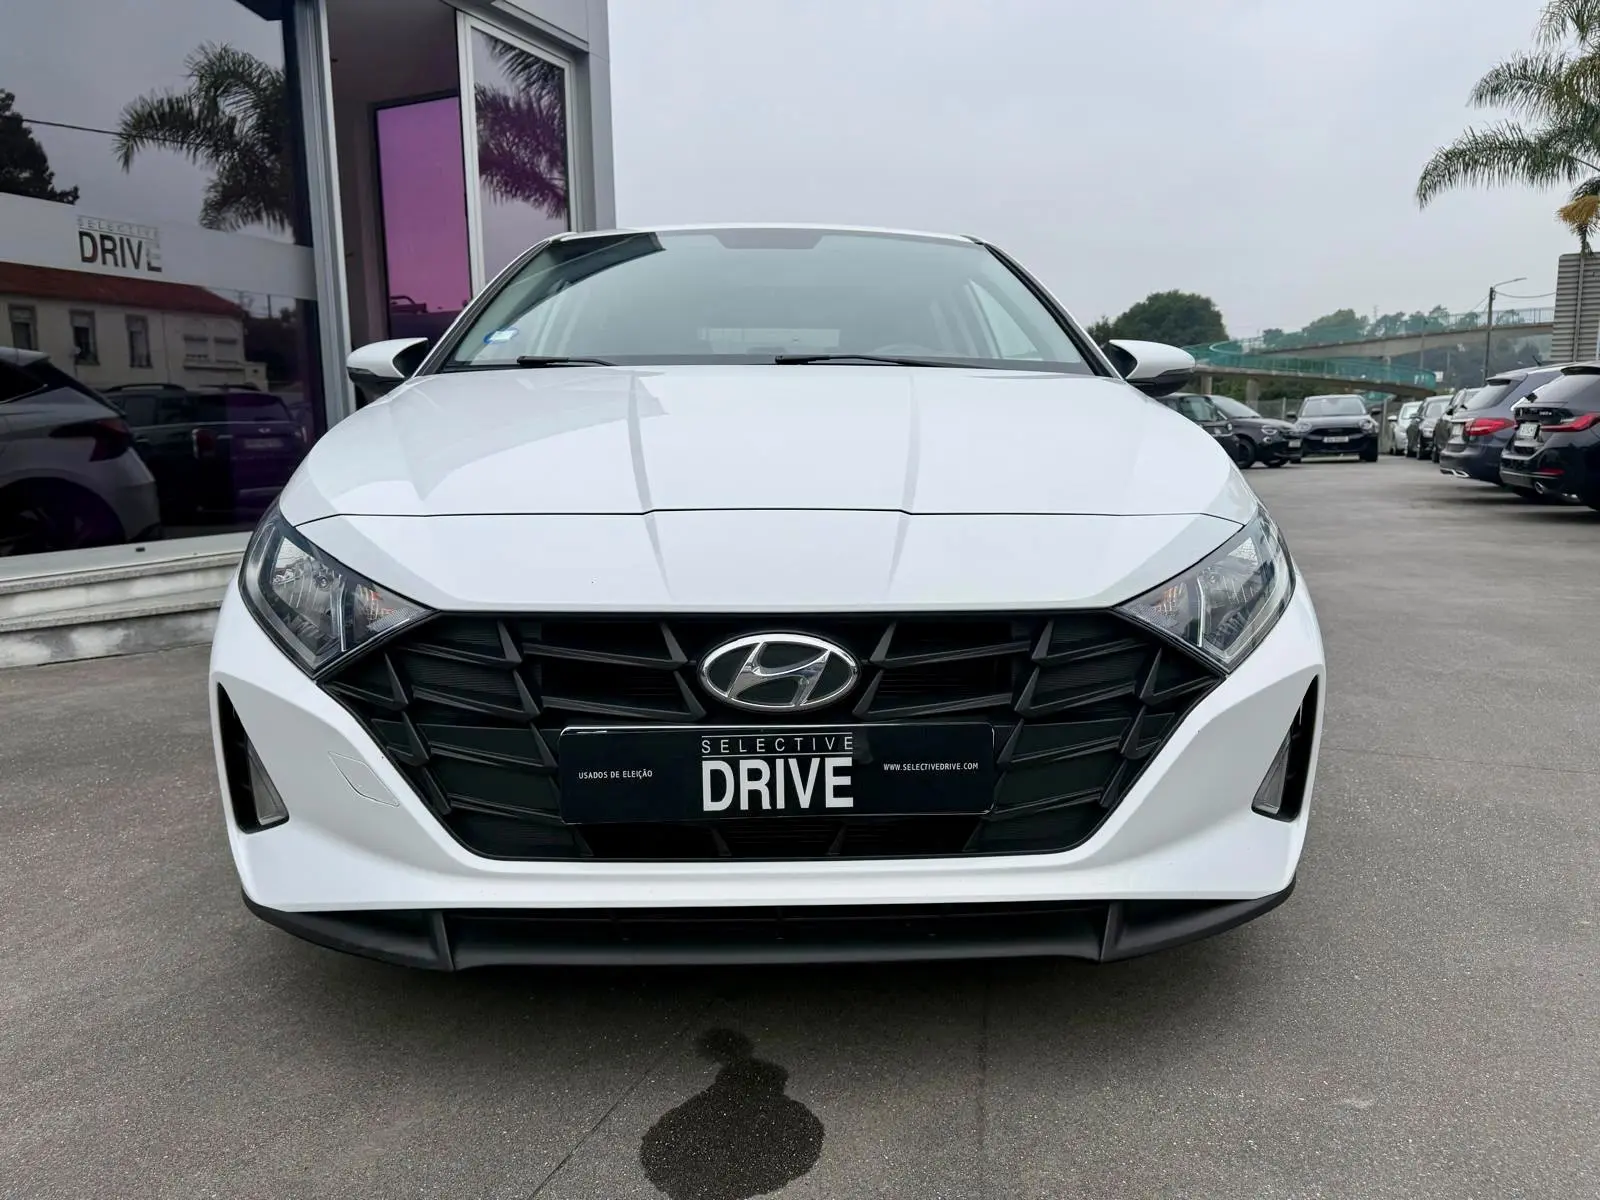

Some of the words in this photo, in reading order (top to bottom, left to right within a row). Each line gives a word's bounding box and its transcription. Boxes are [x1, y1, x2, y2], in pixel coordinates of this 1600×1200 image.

[79, 231, 162, 272] DRIVE
[701, 737, 853, 753] SELECTIVE
[578, 771, 608, 779] USADOS
[622, 768, 653, 779] ELEIÇÃO
[883, 762, 979, 771] WWW.SELECTIVEDRIVE.COM
[702, 757, 853, 811] DRIVE
